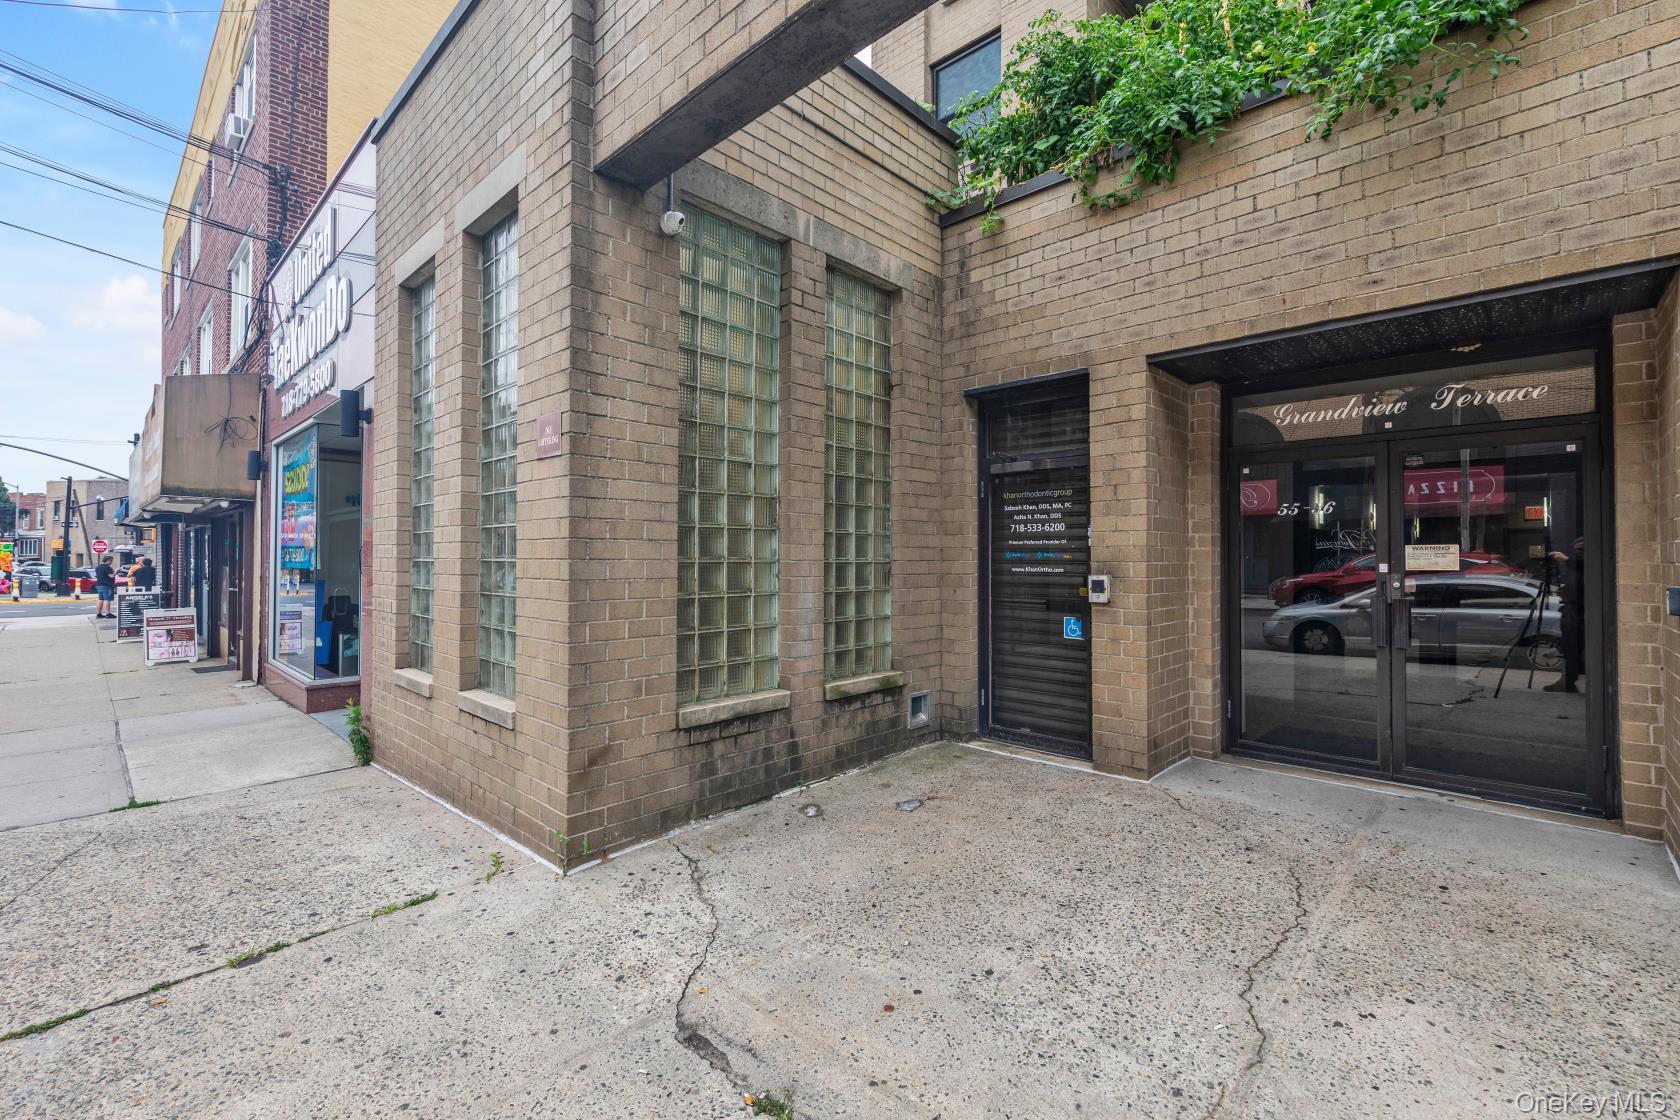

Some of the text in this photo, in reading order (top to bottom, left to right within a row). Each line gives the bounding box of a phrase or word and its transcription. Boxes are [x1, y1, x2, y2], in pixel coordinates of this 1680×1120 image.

[294, 207, 334, 304] United
[1274, 383, 1549, 426] Grandview Terrace
[1004, 490, 1072, 498] khanorthodonticgroup
[1010, 523, 1065, 532] 718-533-6200
